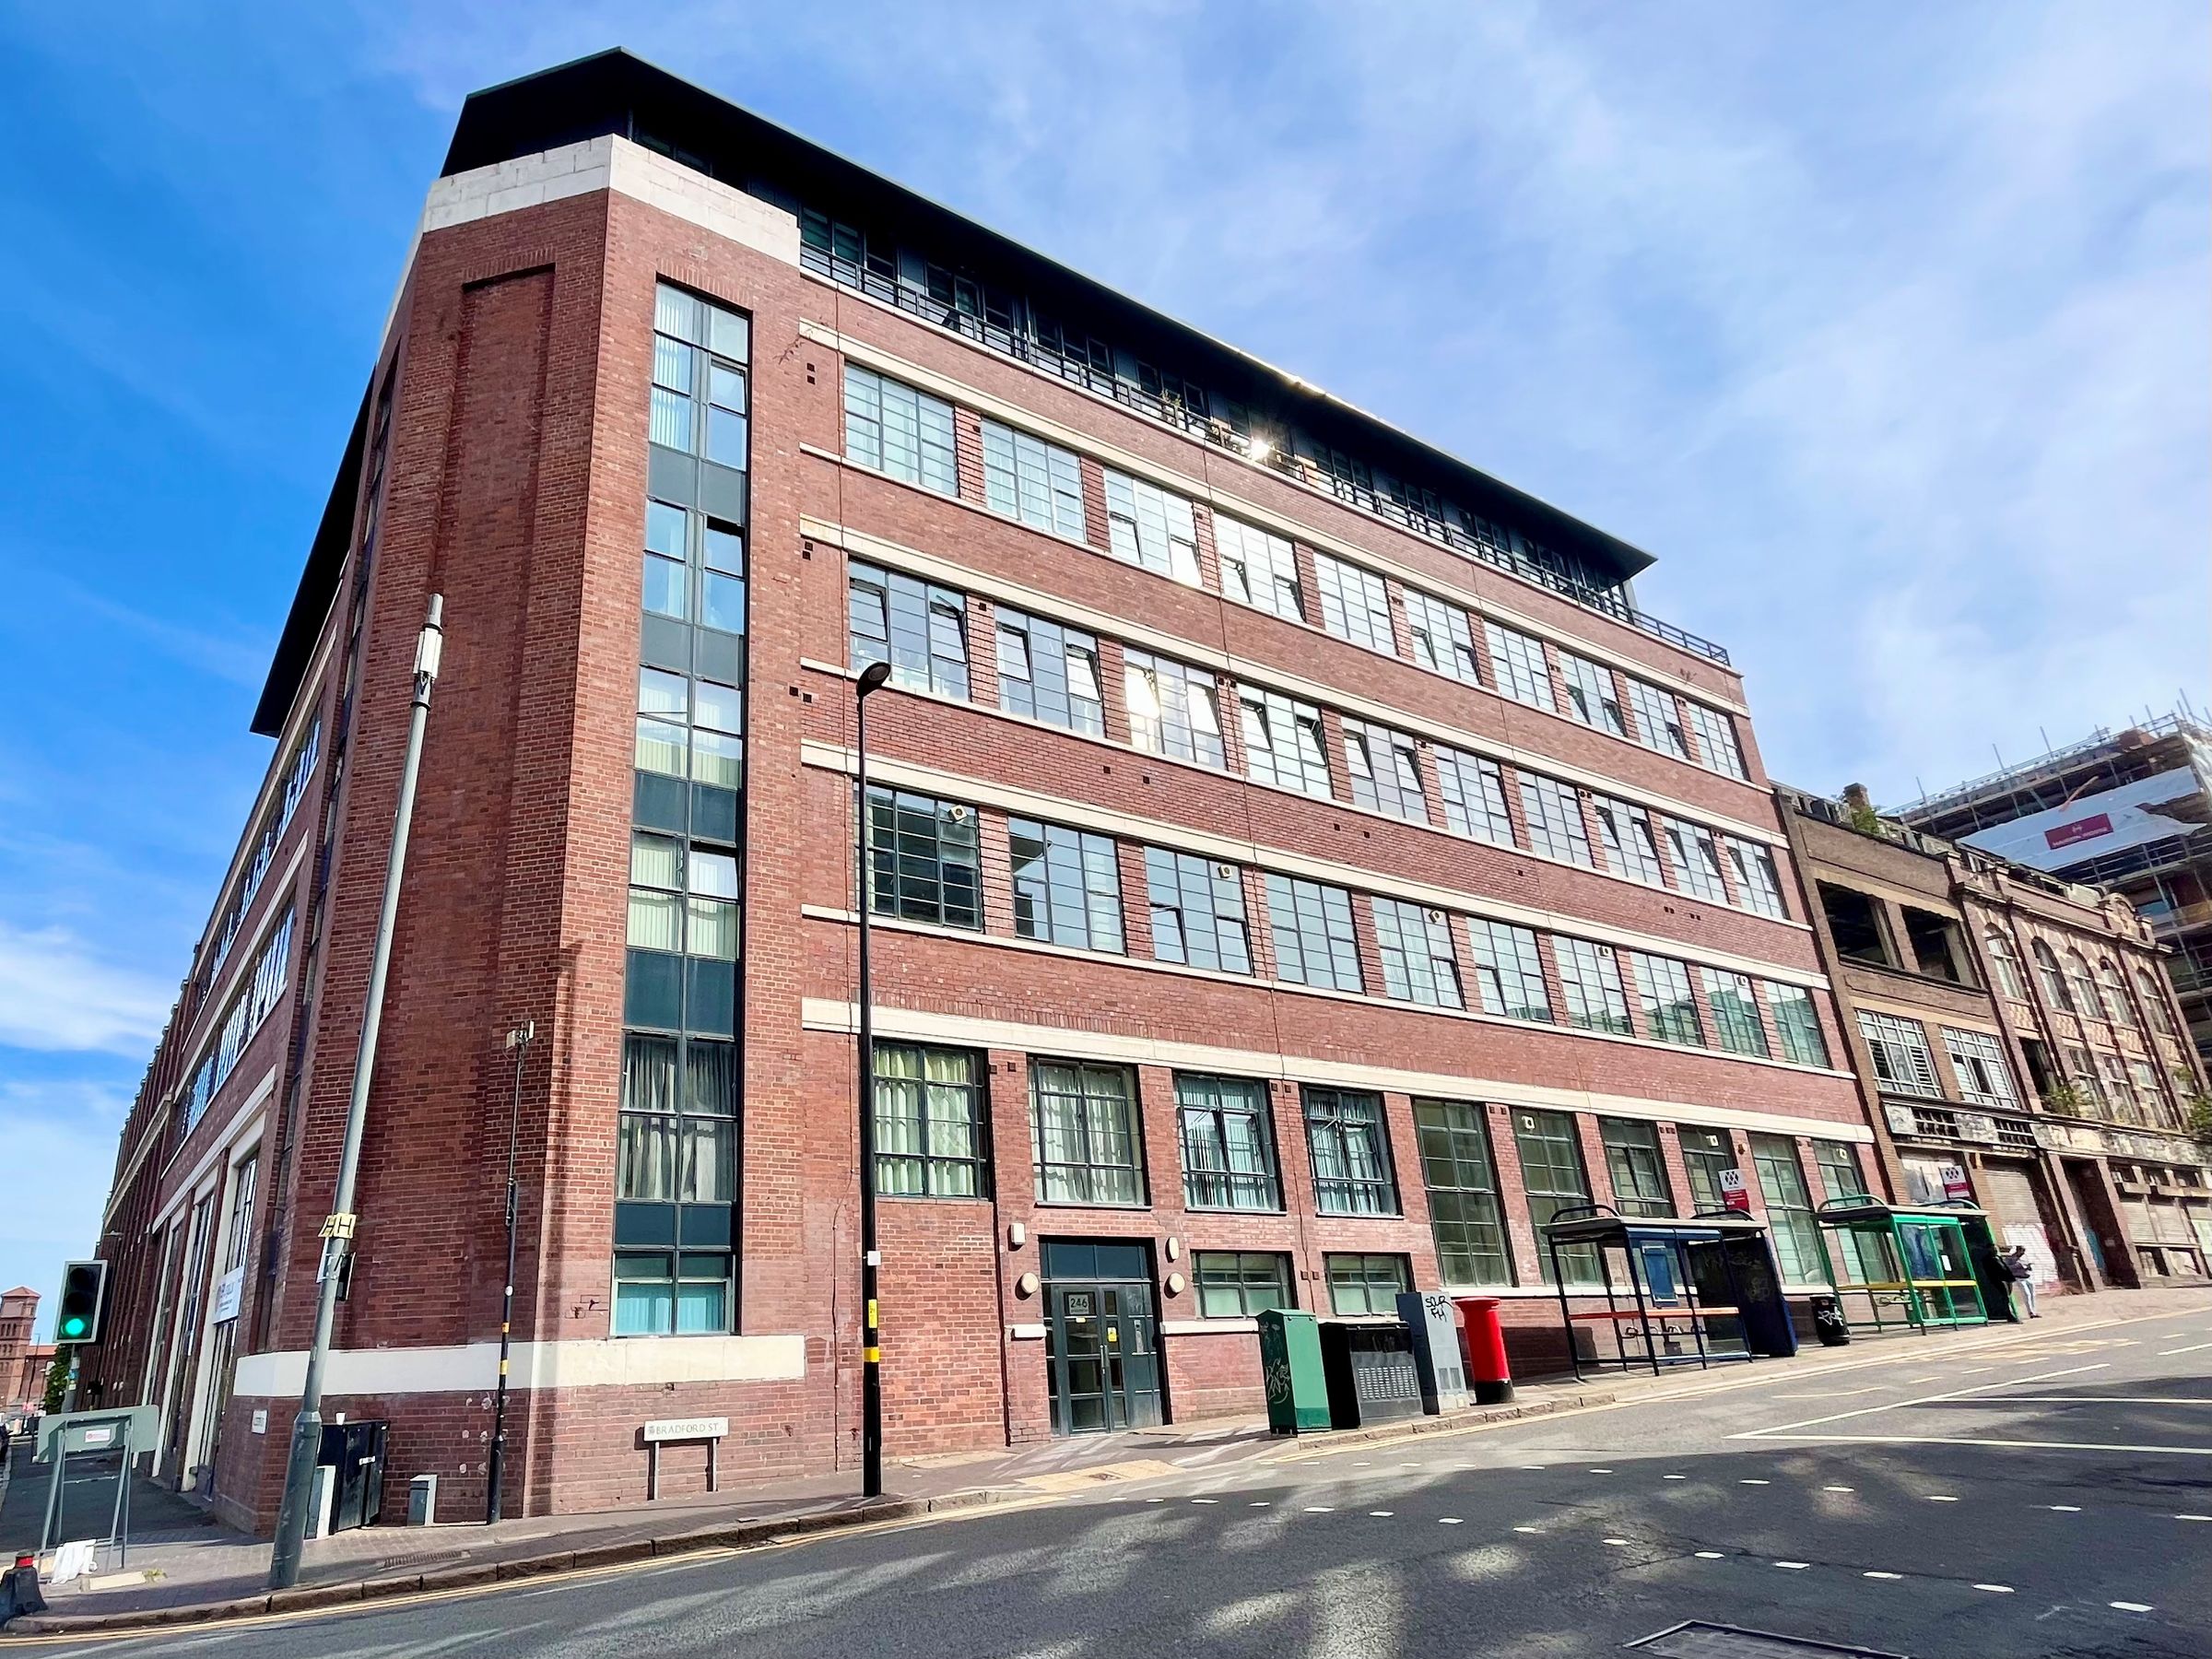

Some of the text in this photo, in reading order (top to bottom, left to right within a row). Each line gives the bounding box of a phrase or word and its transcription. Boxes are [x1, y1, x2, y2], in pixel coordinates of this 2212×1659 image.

[1070, 1298, 1088, 1308] 246
[656, 1423, 719, 1435] BRADFORD ST
